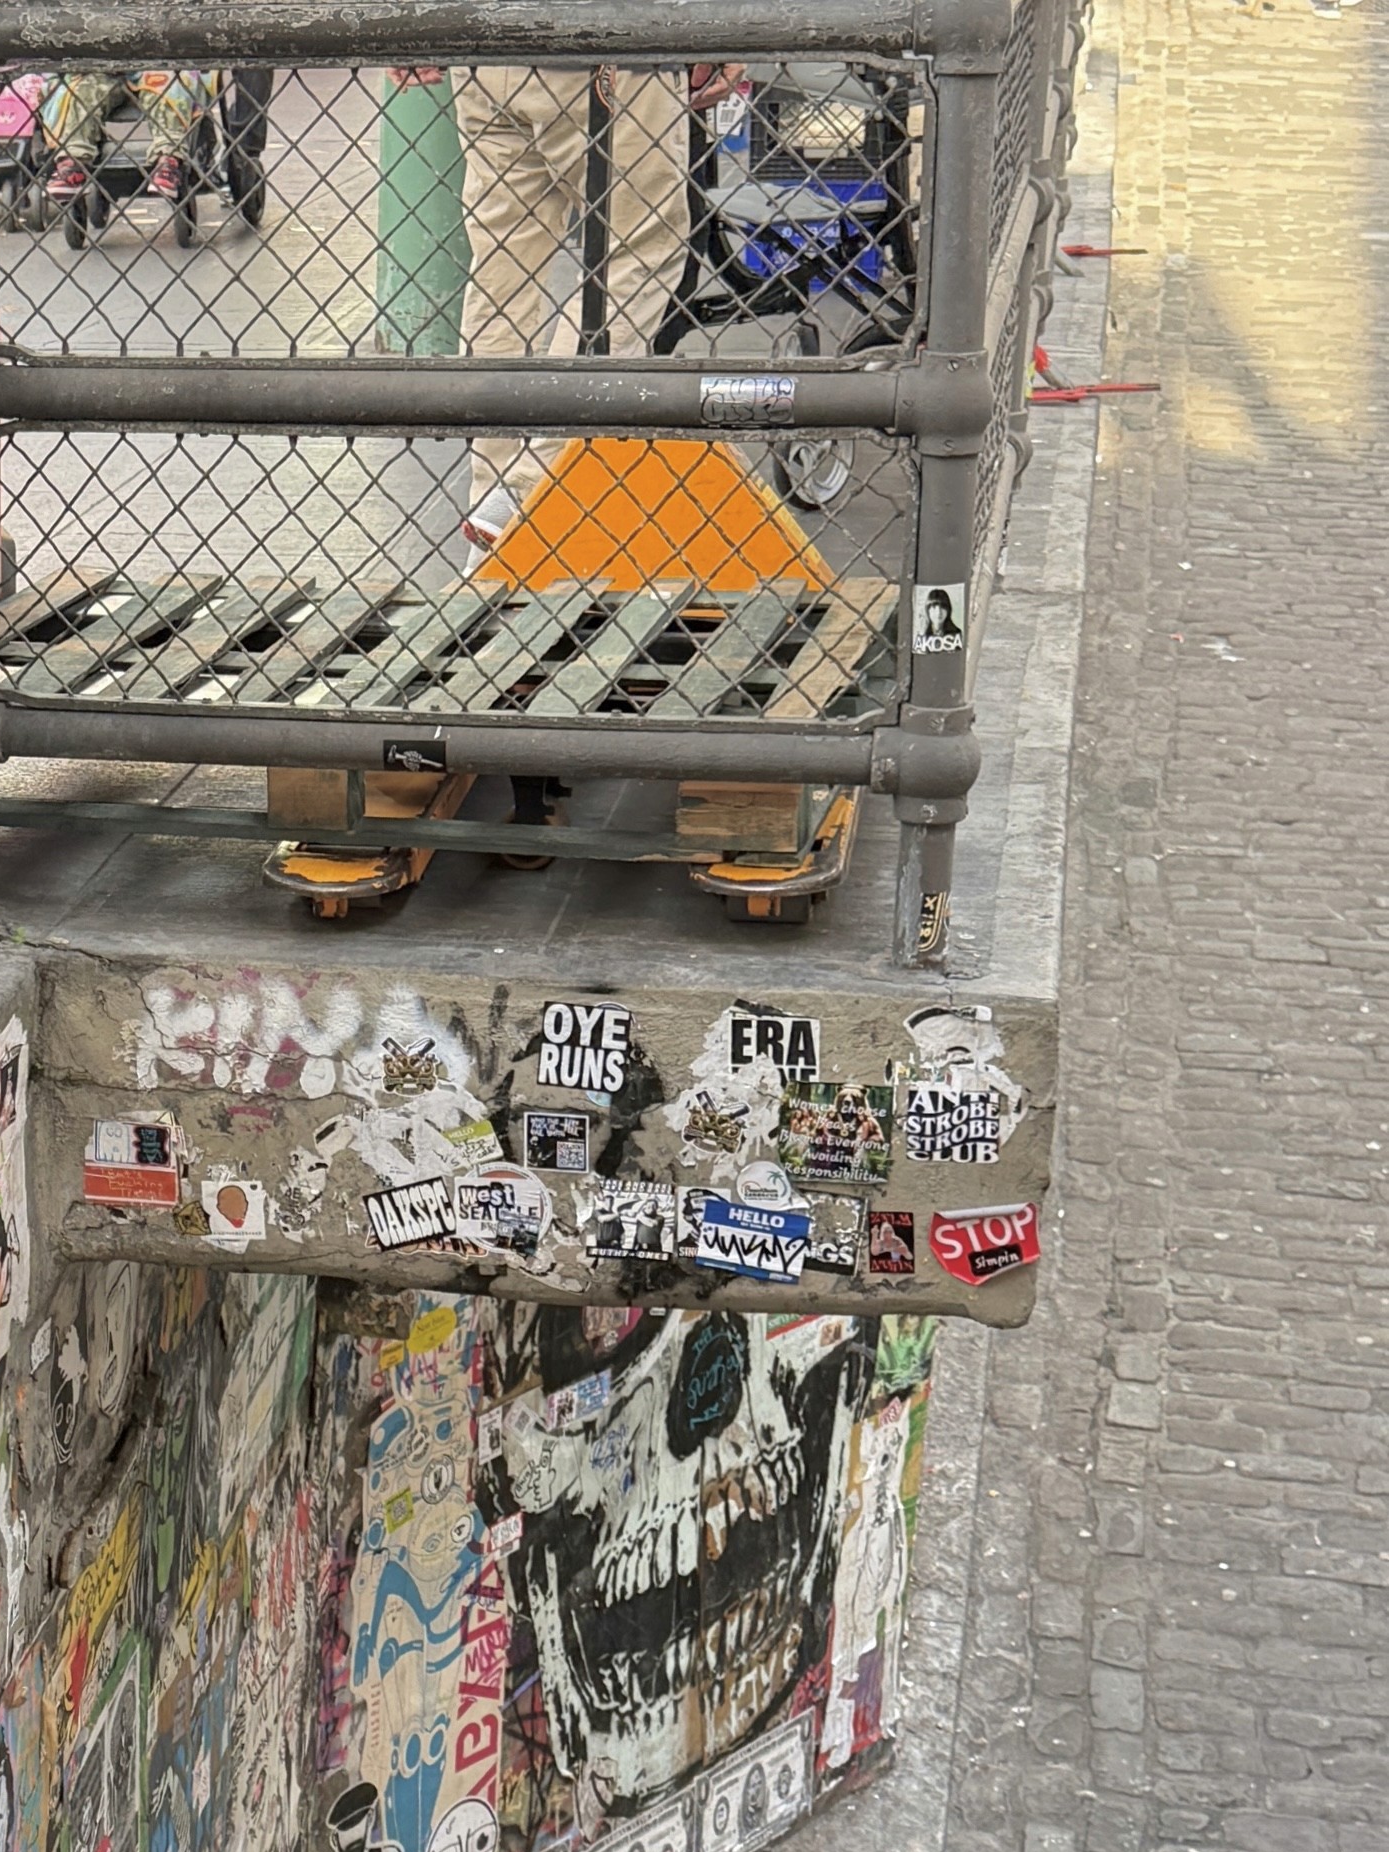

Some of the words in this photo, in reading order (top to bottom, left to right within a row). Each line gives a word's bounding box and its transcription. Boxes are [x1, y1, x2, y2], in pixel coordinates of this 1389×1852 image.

[914, 633, 963, 652] AKOSA
[543, 1003, 630, 1050] OYE
[731, 1018, 817, 1066] ERA
[538, 1043, 625, 1092] RUNS
[909, 1089, 1000, 1113] ANTI
[907, 1103, 1000, 1135] STROBE
[827, 1135, 891, 1152] Everyone
[907, 1120, 1000, 1151] STROBE
[802, 1147, 862, 1168] Avoiding
[907, 1142, 1000, 1164] CLUB
[784, 1162, 879, 1182] Responsibility
[459, 1183, 515, 1208] West
[729, 1207, 785, 1229] HELLO
[935, 1207, 1034, 1260] STOP
